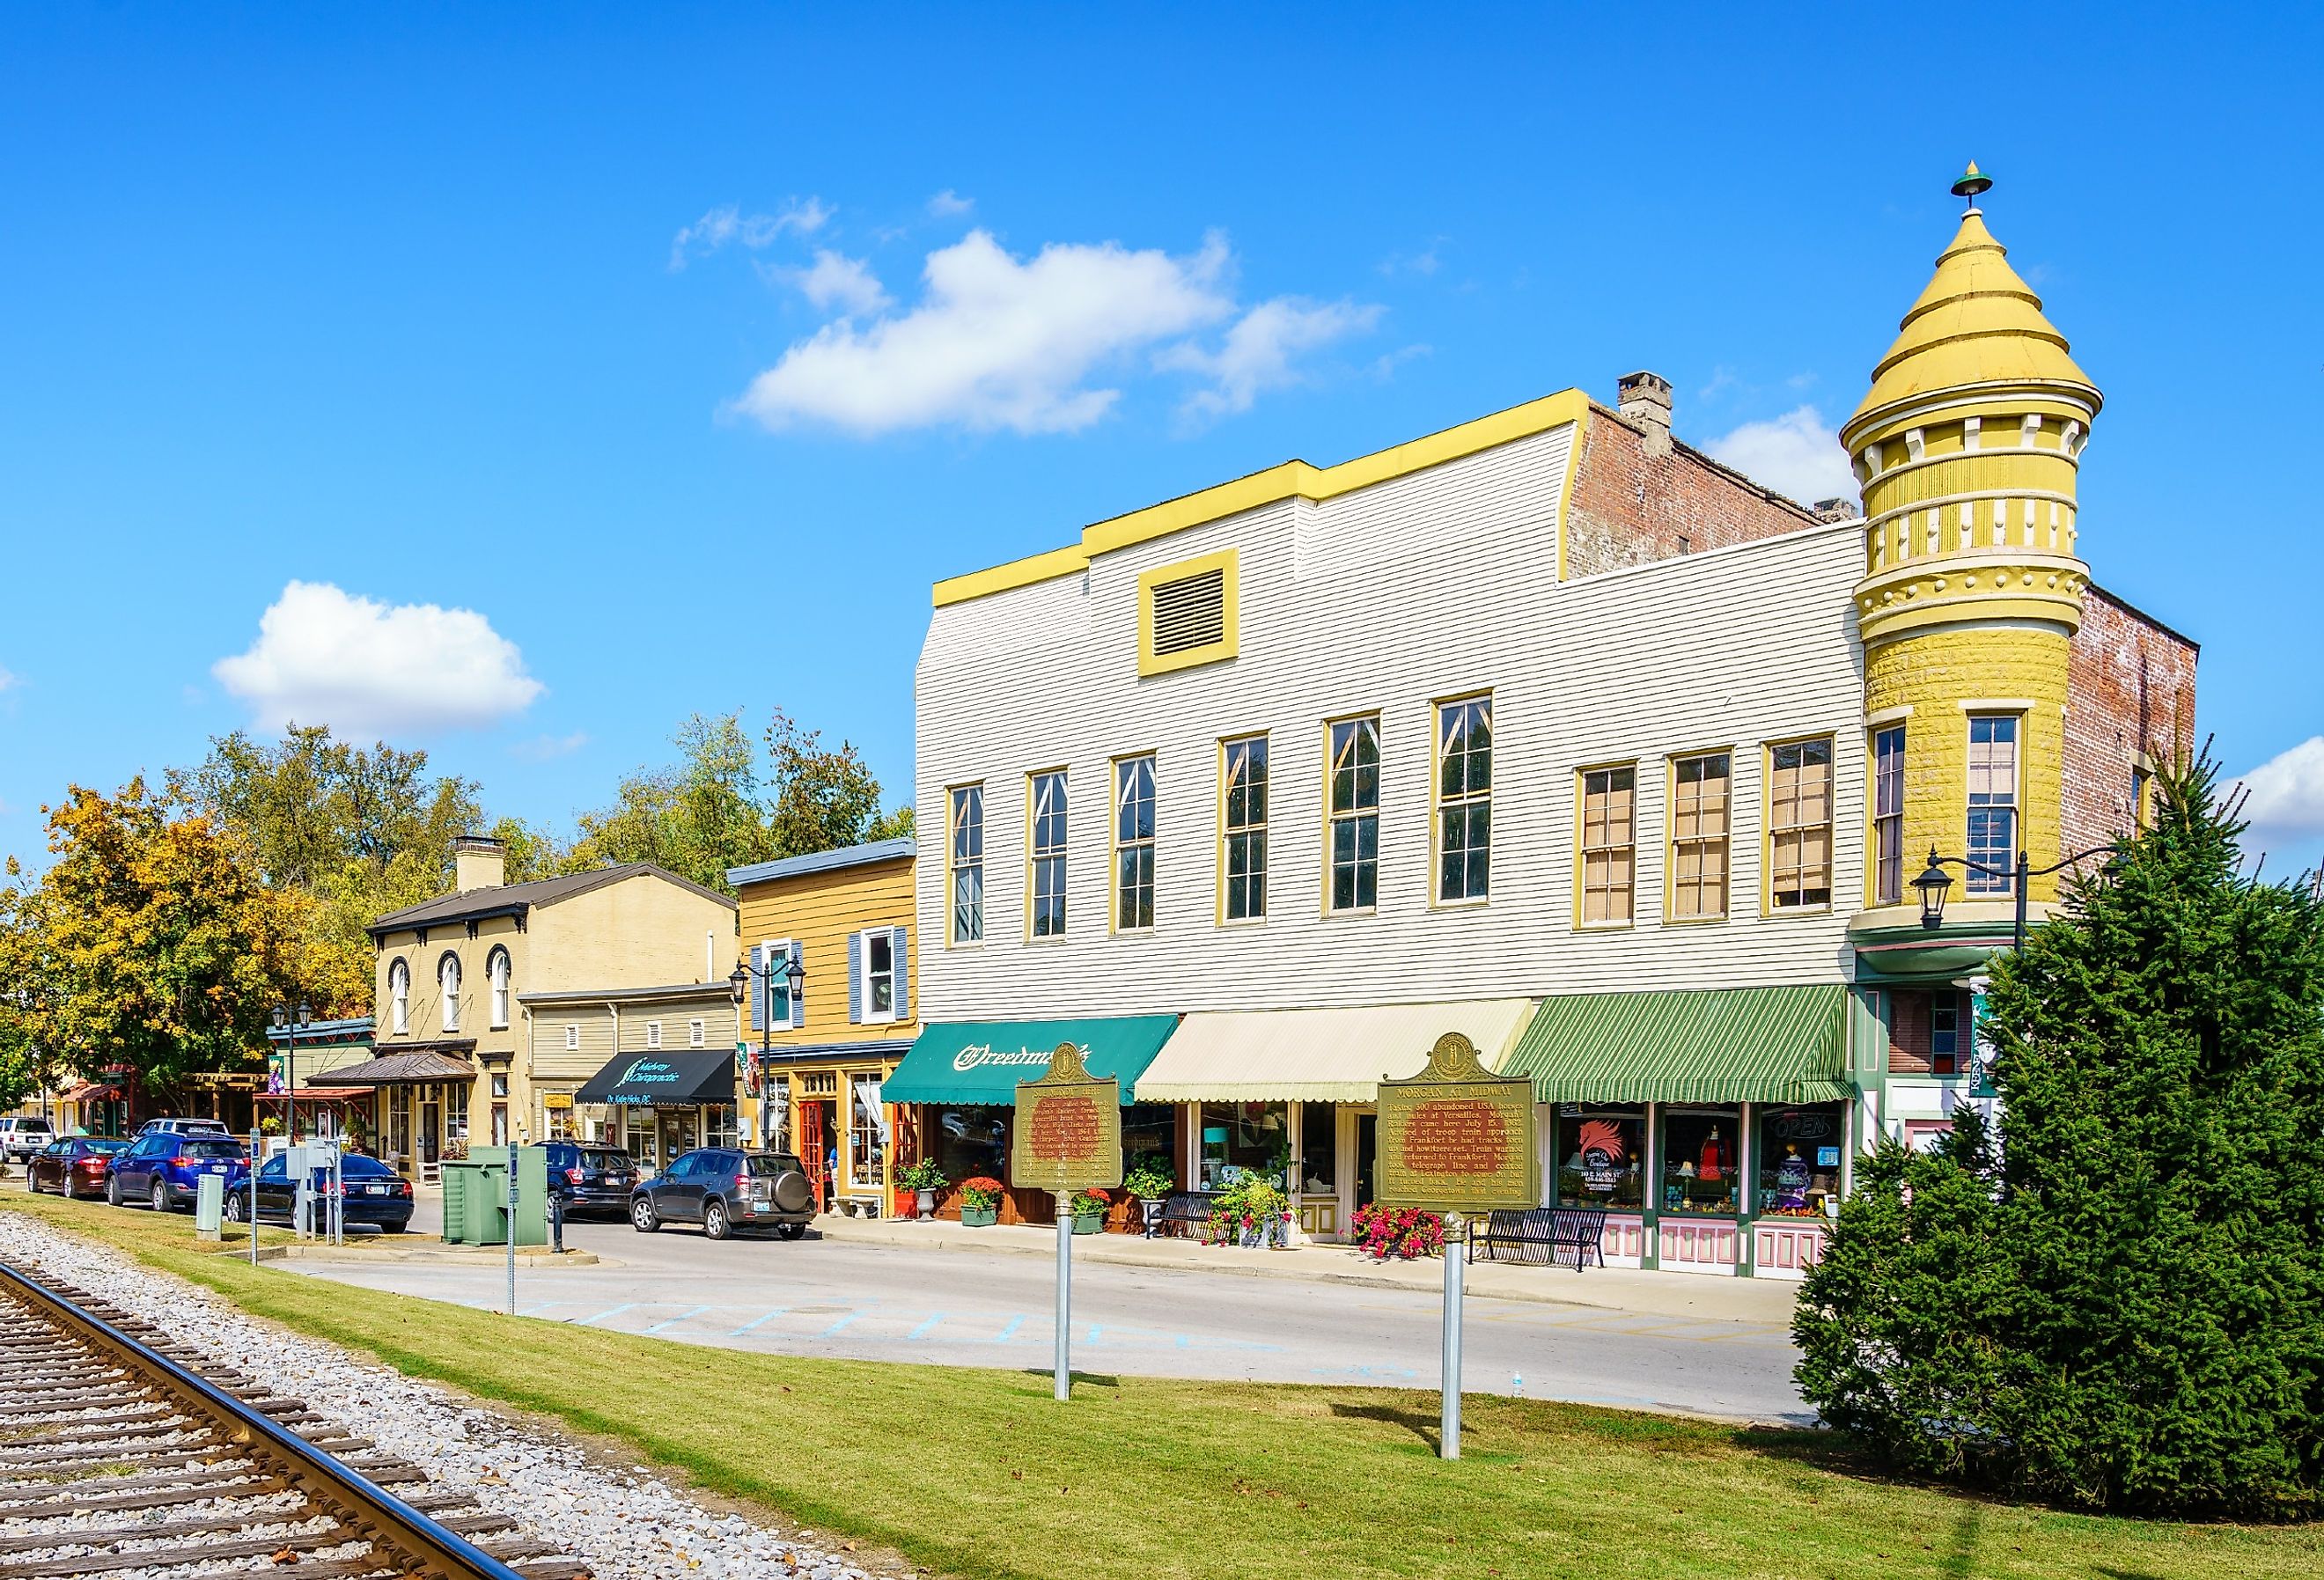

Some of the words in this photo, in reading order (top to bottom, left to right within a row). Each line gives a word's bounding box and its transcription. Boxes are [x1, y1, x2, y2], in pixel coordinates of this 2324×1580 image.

[637, 1062, 671, 1071] Midway
[629, 1072, 680, 1084] Chiropractic
[1397, 1088, 1442, 1099] MORGAN
[1449, 1088, 1463, 1098] AT
[1470, 1086, 1513, 1097] MIDWAY
[1465, 1120, 1482, 1128] July
[1776, 1116, 1825, 1138] OPEN
[1494, 1153, 1523, 1162] Morgan
[1411, 1162, 1446, 1171] telegraph
[1491, 1188, 1524, 1198] evening.
